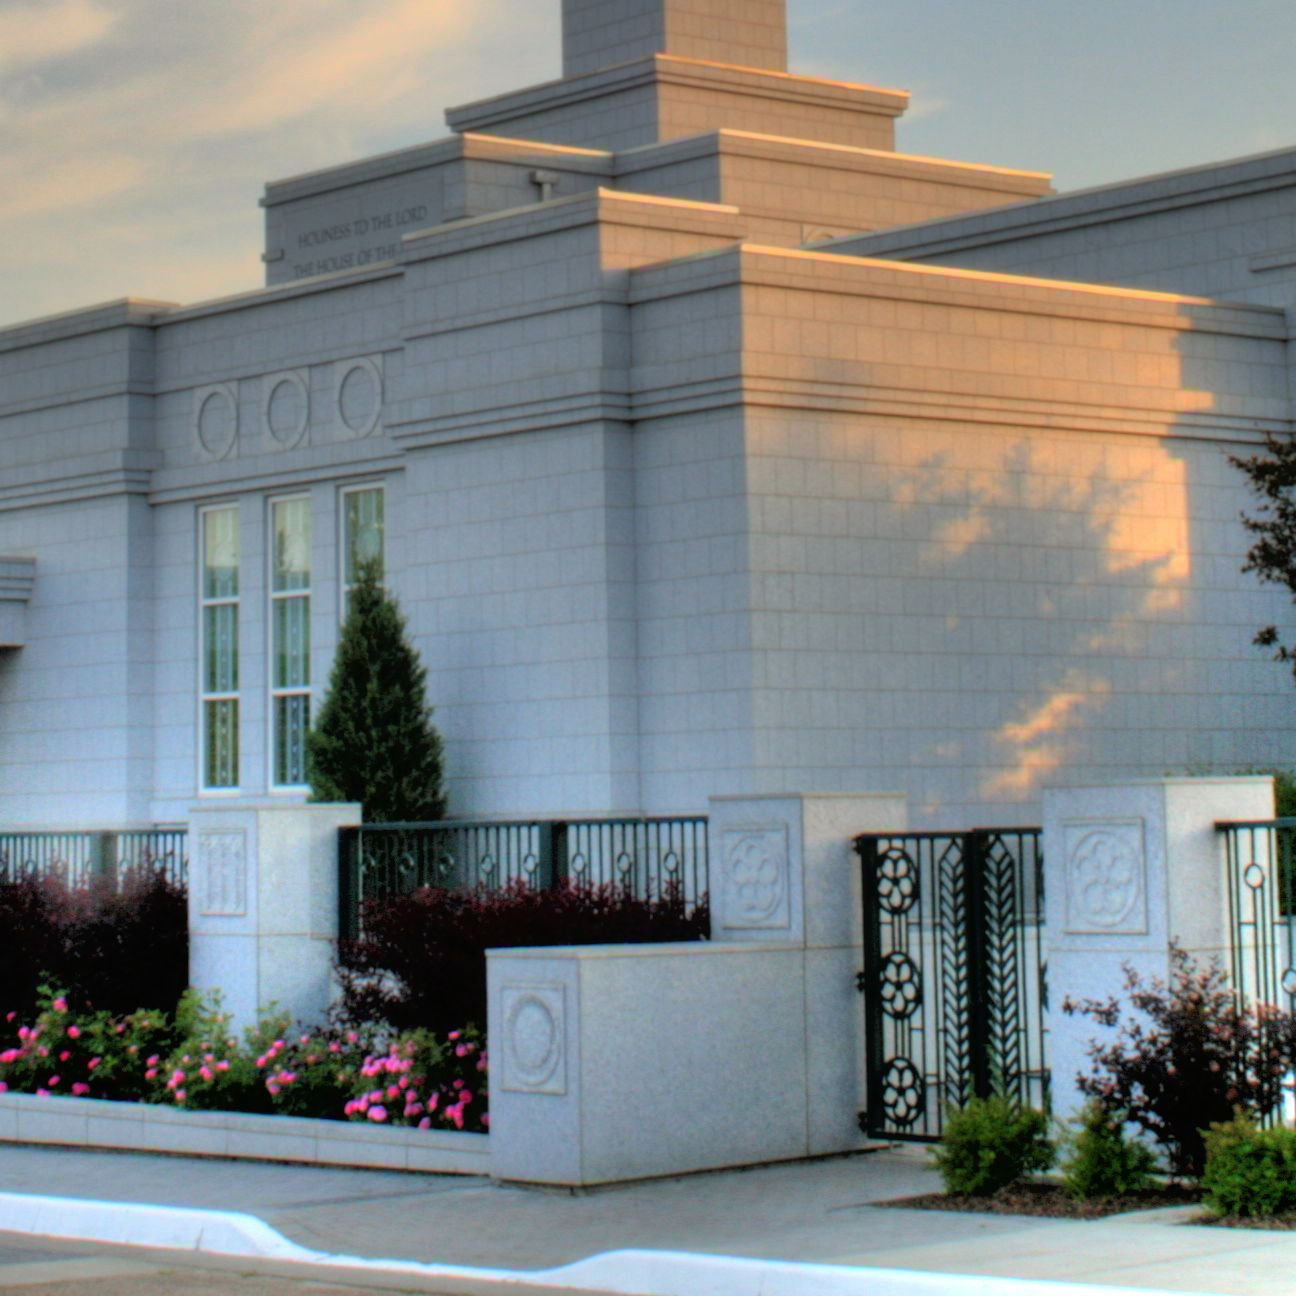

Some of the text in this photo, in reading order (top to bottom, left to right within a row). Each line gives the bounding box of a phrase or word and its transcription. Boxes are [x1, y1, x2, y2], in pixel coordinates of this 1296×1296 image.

[298, 205, 427, 248] HOLINESS TO THE LORD
[294, 244, 396, 278] THE HOUSE OF THE
